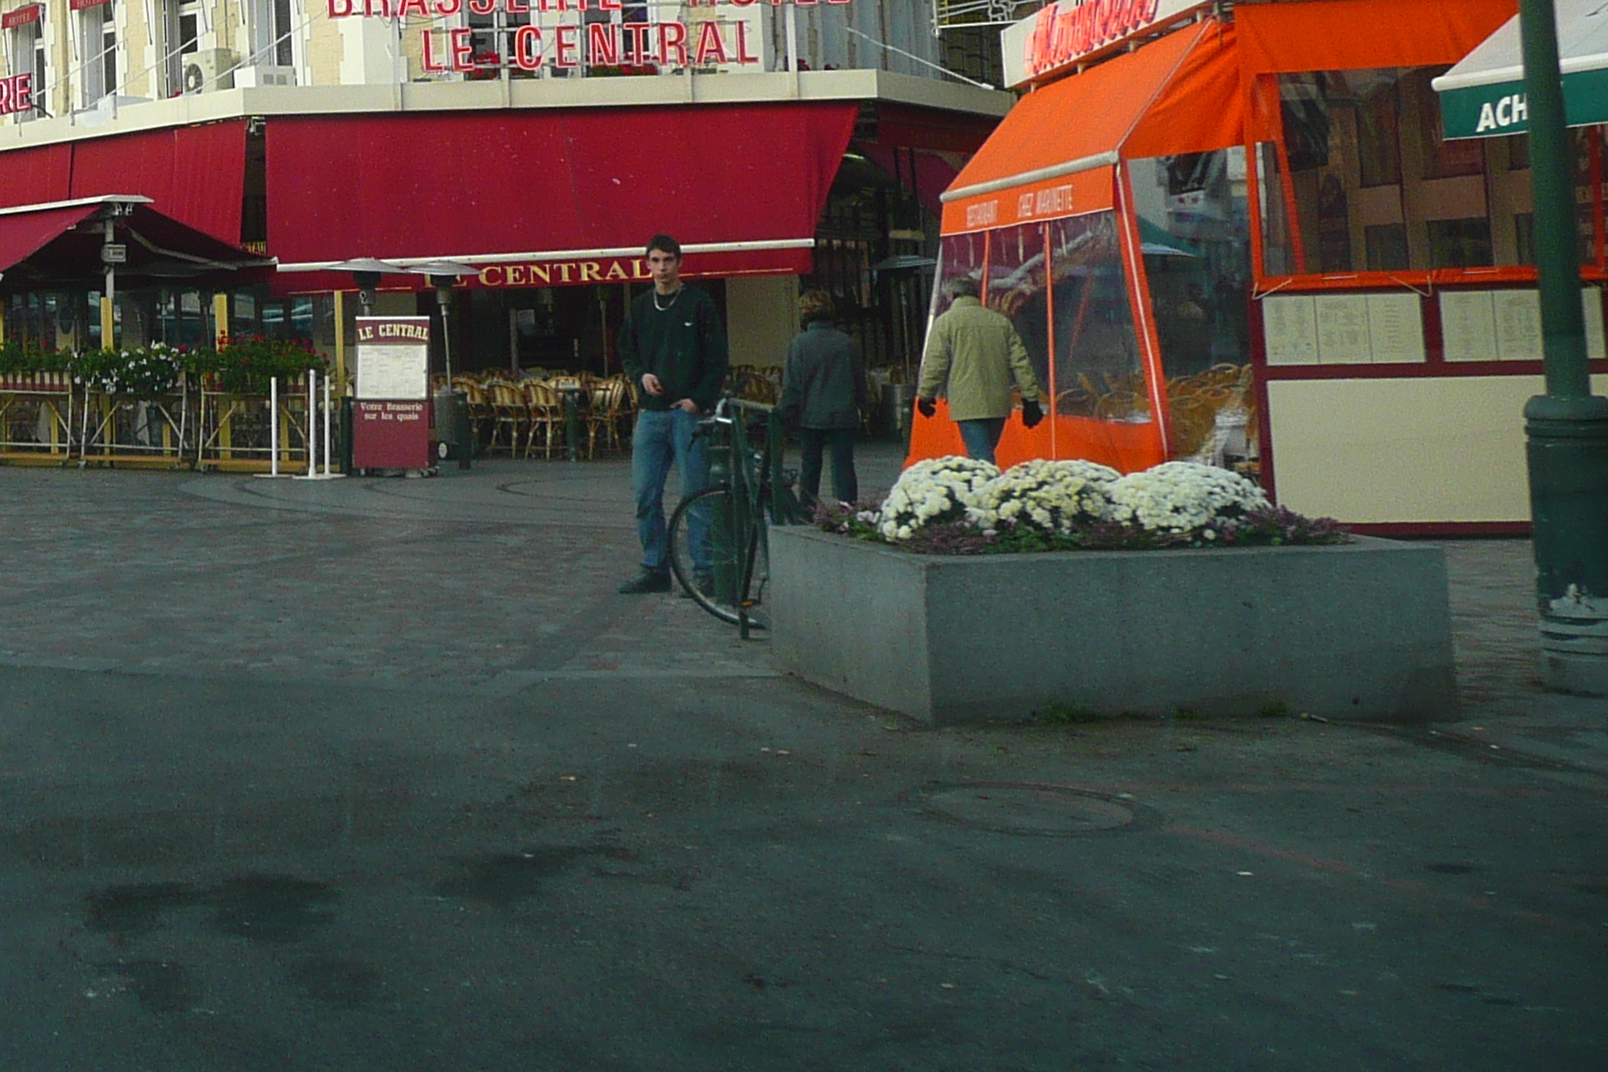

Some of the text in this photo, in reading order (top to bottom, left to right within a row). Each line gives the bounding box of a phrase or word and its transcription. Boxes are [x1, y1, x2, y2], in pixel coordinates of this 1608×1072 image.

[8, 11, 31, 26] HOTEL
[421, 20, 759, 72] LE CENTRAL
[1475, 93, 1529, 133] ACH
[478, 258, 651, 286] CENTRAL
[358, 323, 429, 341] LE CENTRAL
[360, 402, 424, 411] Votre Brasserie
[381, 412, 393, 420] les
[396, 412, 420, 422] quais
